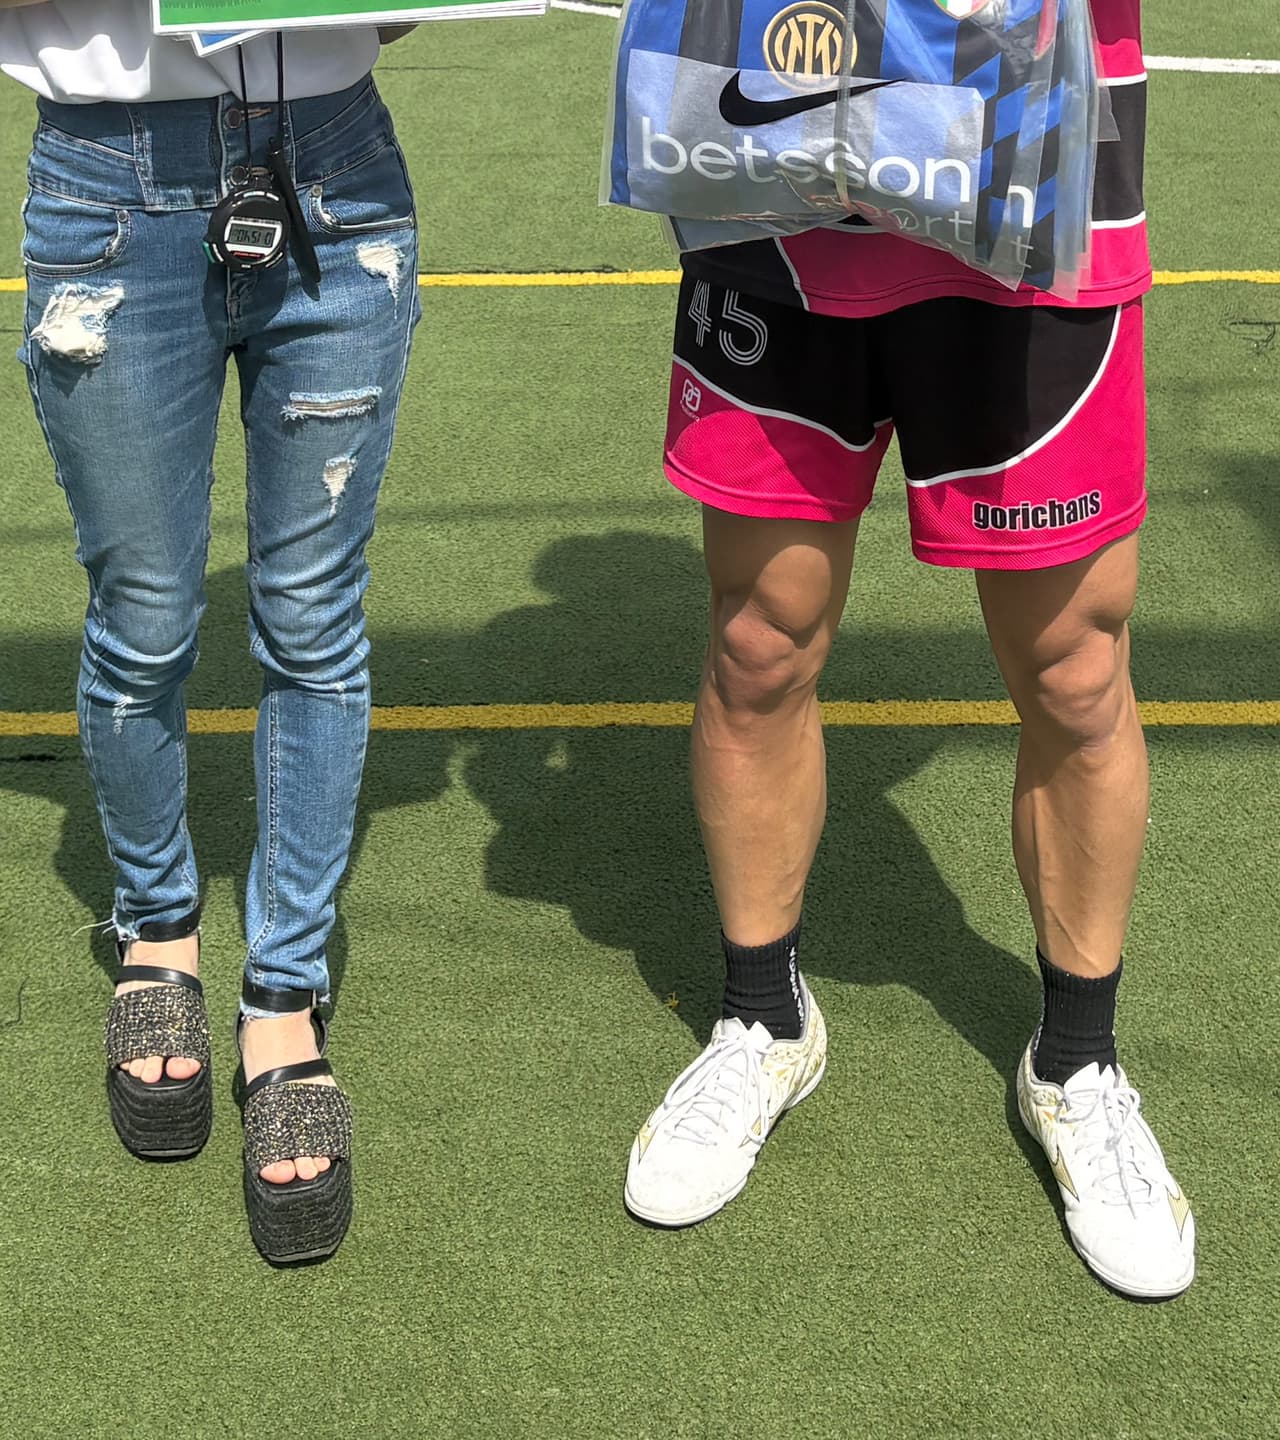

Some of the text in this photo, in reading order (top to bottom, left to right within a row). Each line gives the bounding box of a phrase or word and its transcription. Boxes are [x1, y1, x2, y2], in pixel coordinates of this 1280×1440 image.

[641, 116, 972, 203] betsson
[687, 279, 769, 366] 45
[972, 489, 1102, 532] gorichans
